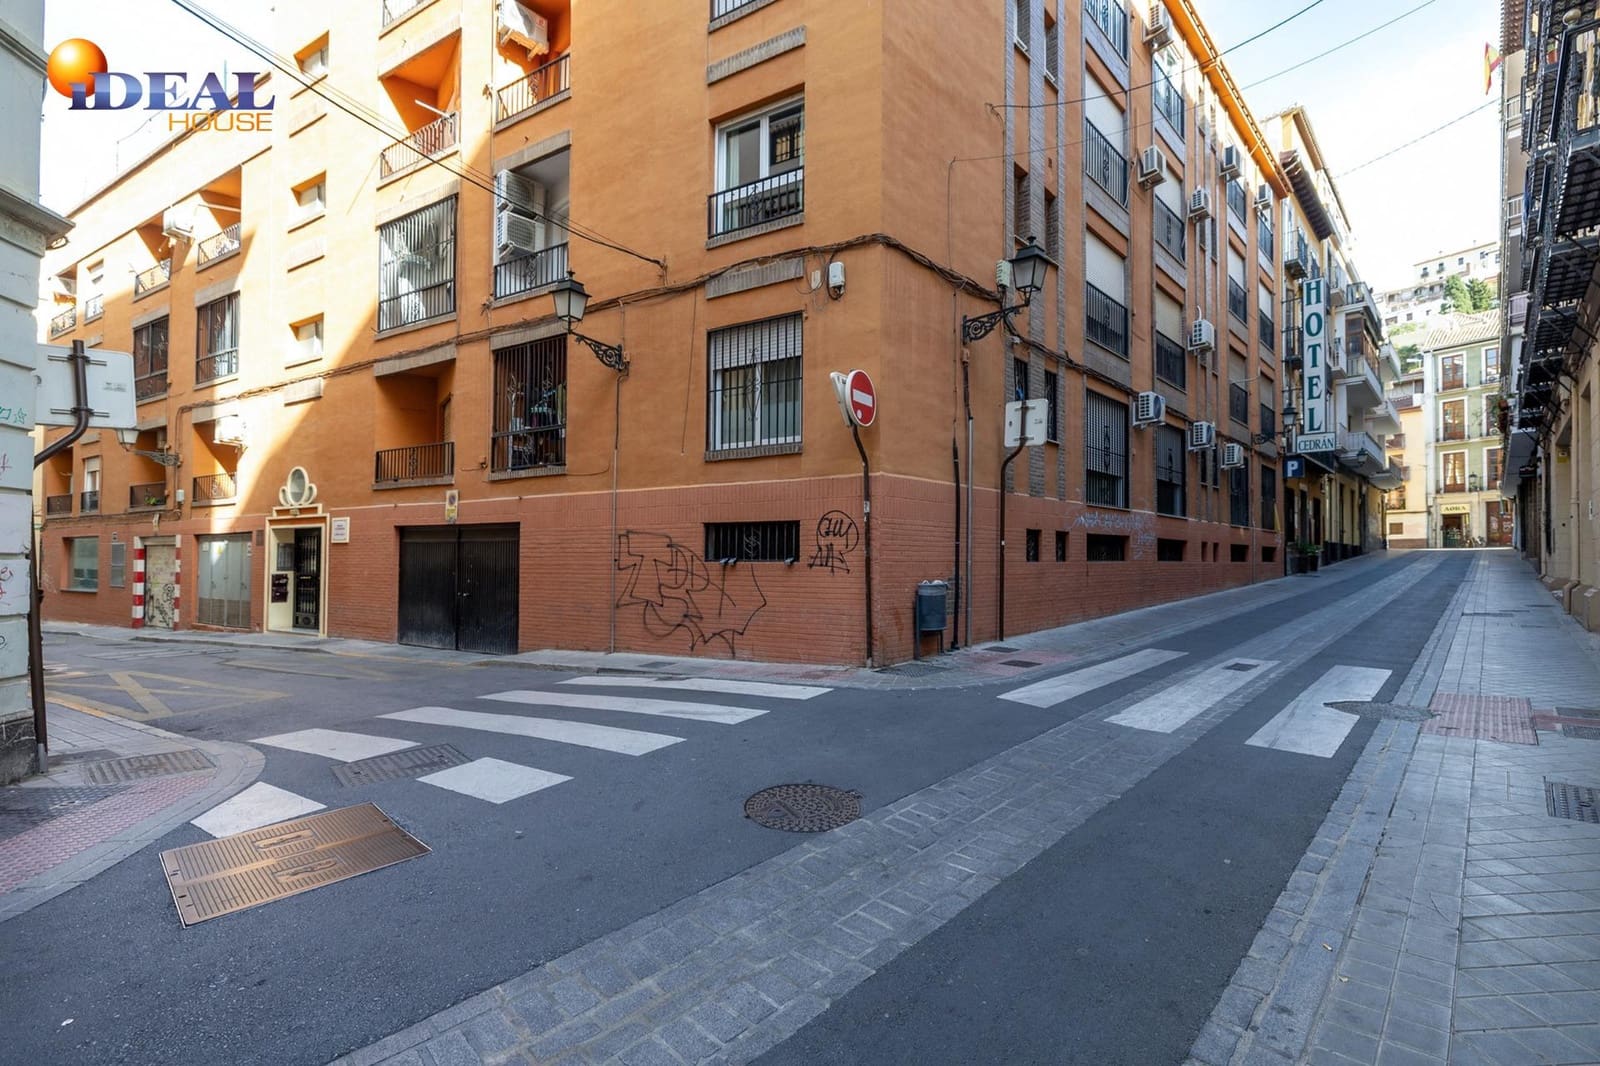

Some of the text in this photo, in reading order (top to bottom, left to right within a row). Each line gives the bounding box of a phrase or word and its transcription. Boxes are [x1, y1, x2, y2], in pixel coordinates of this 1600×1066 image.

[1305, 281, 1323, 432] HOTEL
[1298, 436, 1334, 450] CEDRÁN
[1287, 460, 1299, 477] P
